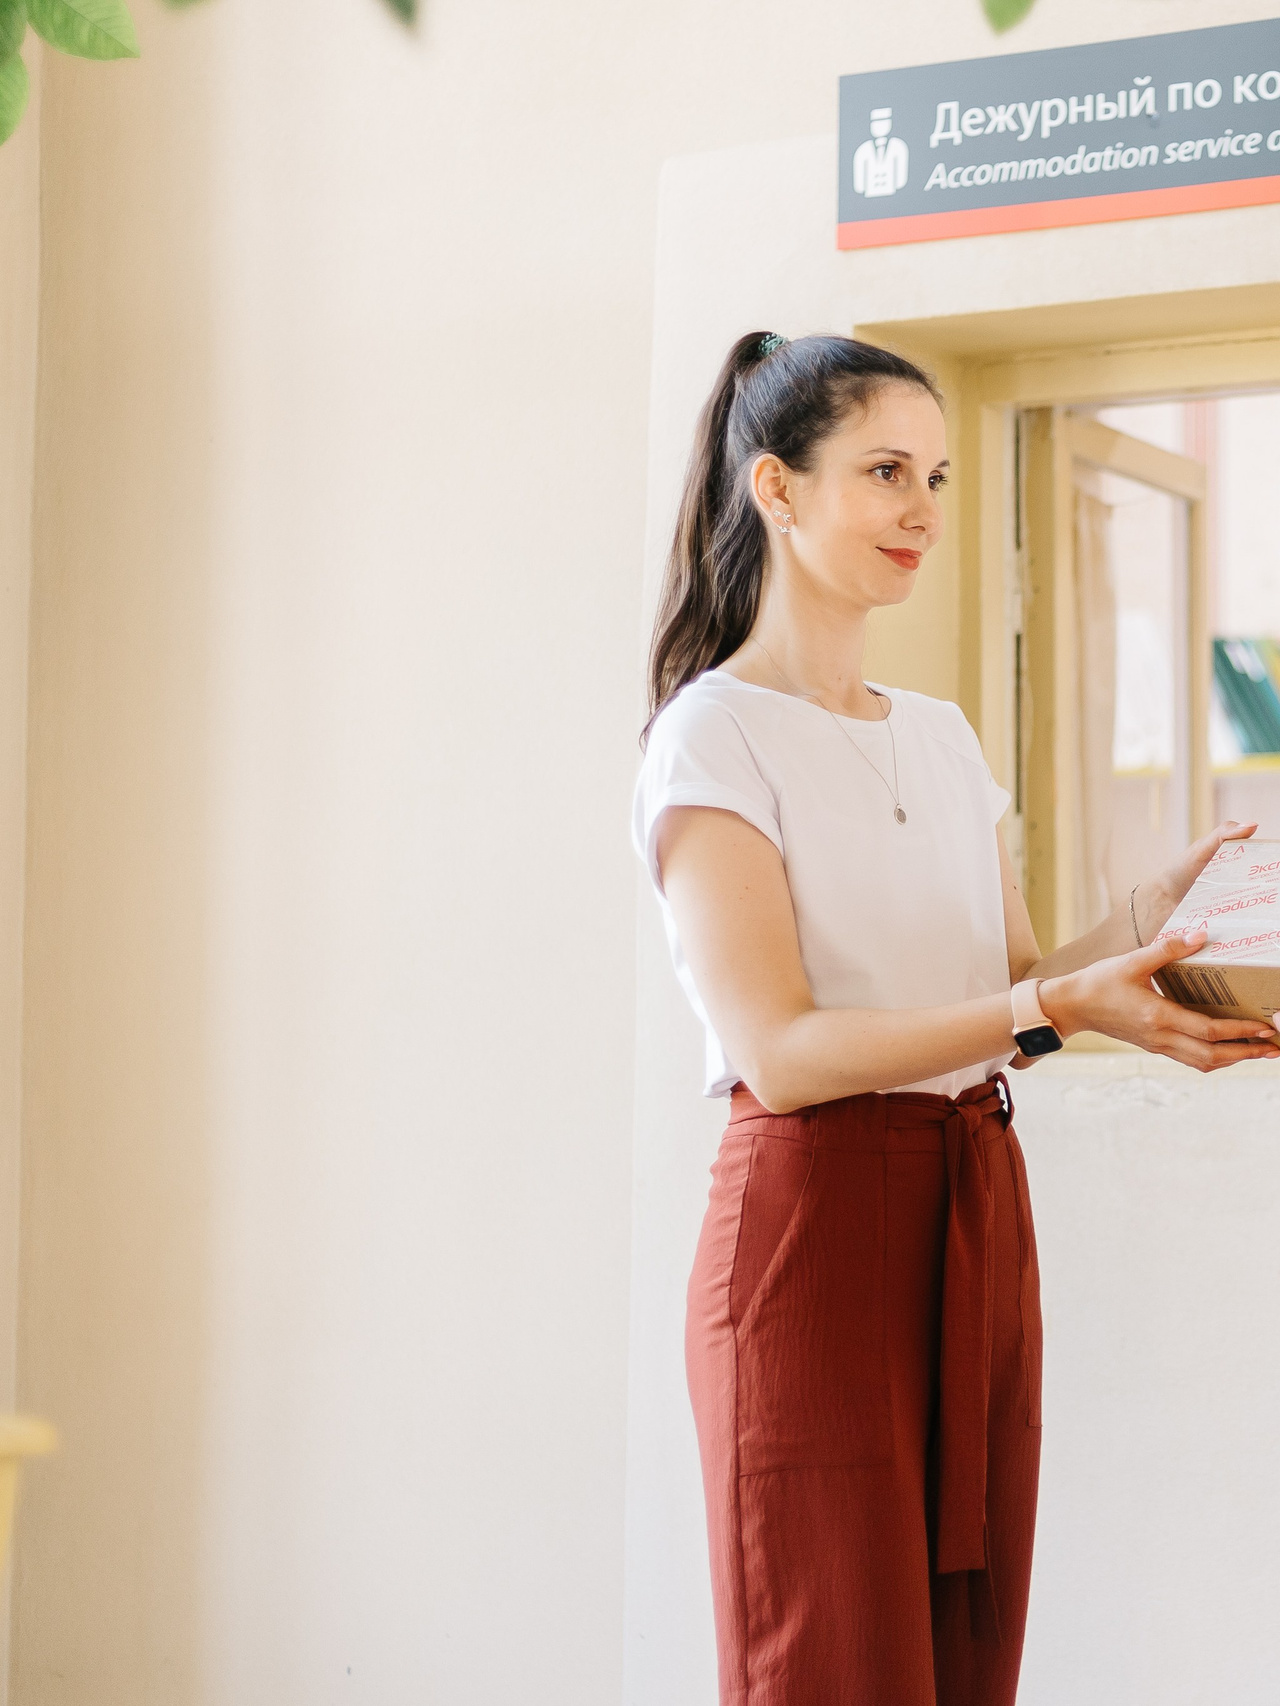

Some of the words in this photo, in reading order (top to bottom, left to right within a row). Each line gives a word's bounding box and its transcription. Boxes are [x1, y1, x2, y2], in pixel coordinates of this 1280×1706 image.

[929, 76, 1156, 148] Дежурный
[1167, 79, 1222, 113] по
[924, 141, 1158, 191] Accommodation
[1163, 127, 1261, 165] service
